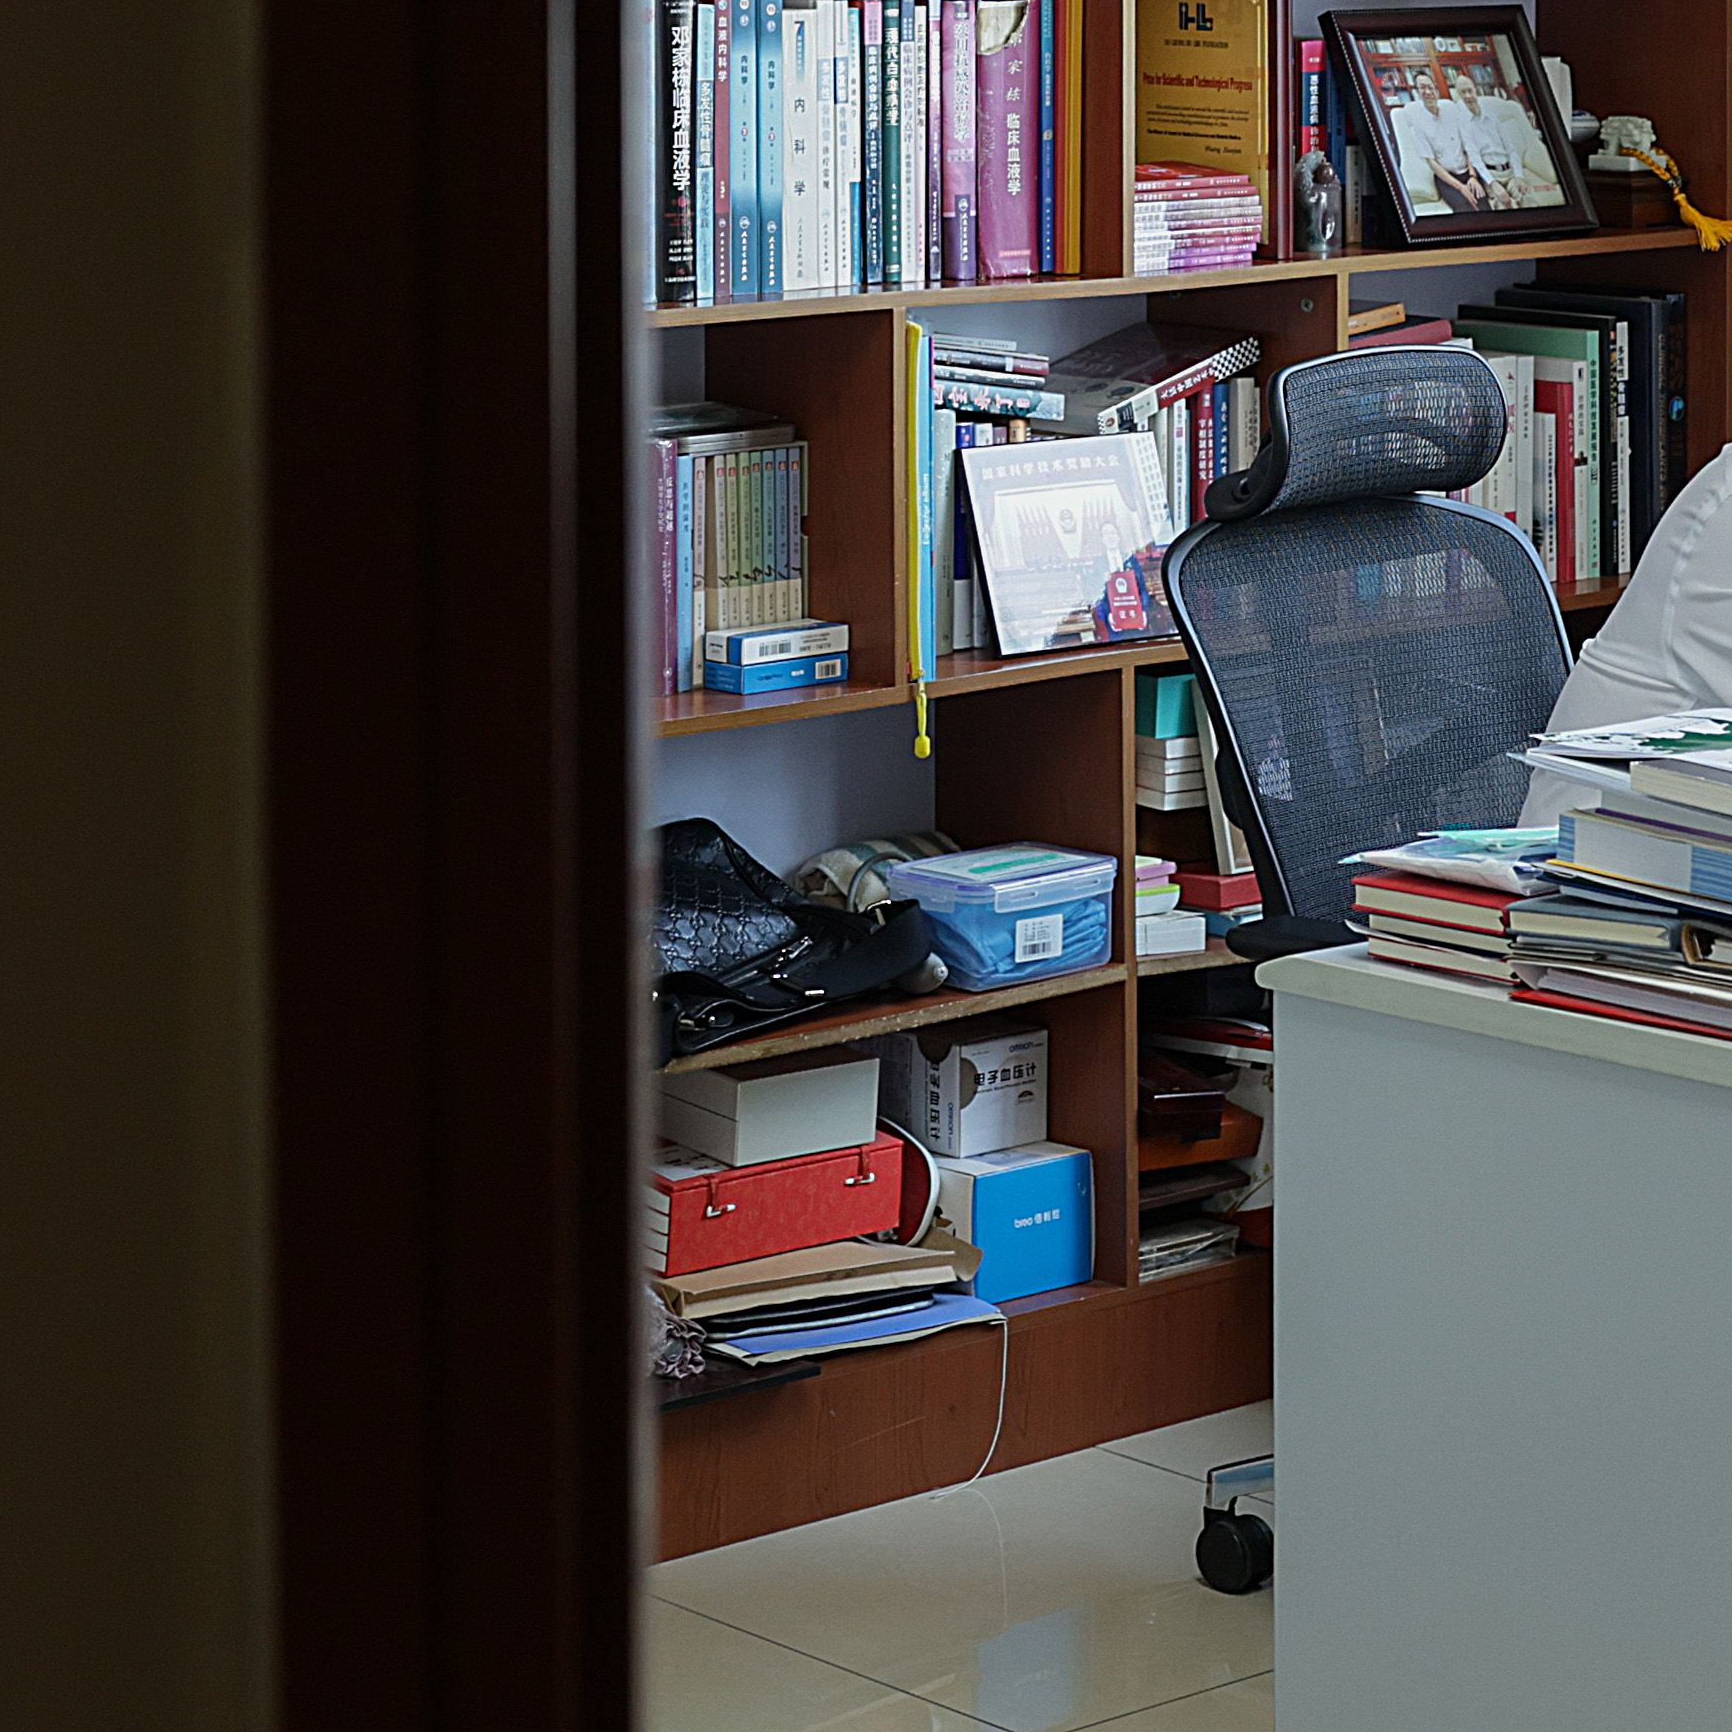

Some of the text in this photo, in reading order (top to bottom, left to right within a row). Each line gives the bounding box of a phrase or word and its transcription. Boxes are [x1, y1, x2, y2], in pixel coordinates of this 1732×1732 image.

[718, 16, 728, 83] 血液内科学
[794, 20, 805, 38] 7
[740, 54, 748, 85] 内科学
[768, 60, 776, 91] 内科学
[884, 27, 900, 126] 现代白血病学
[953, 22, 970, 144] 实用抗感染治疗学
[1162, 73, 1185, 87] Scientific
[1185, 75, 1195, 87] and
[1195, 75, 1229, 92] Technological
[1230, 77, 1253, 93] Progress
[1309, 74, 1319, 124] 恶性血液病
[671, 25, 692, 191] 邓家栋临床血液学
[700, 81, 712, 166] 多发性骨髓瘤
[794, 98, 806, 196] 内科学
[1006, 113, 1022, 196] 临床血液学
[1589, 359, 1598, 463] 中国医学科技发展报告
[981, 454, 1119, 481] 国家科学技术奖励大会
[973, 1062, 1037, 1086] 电子血压计
